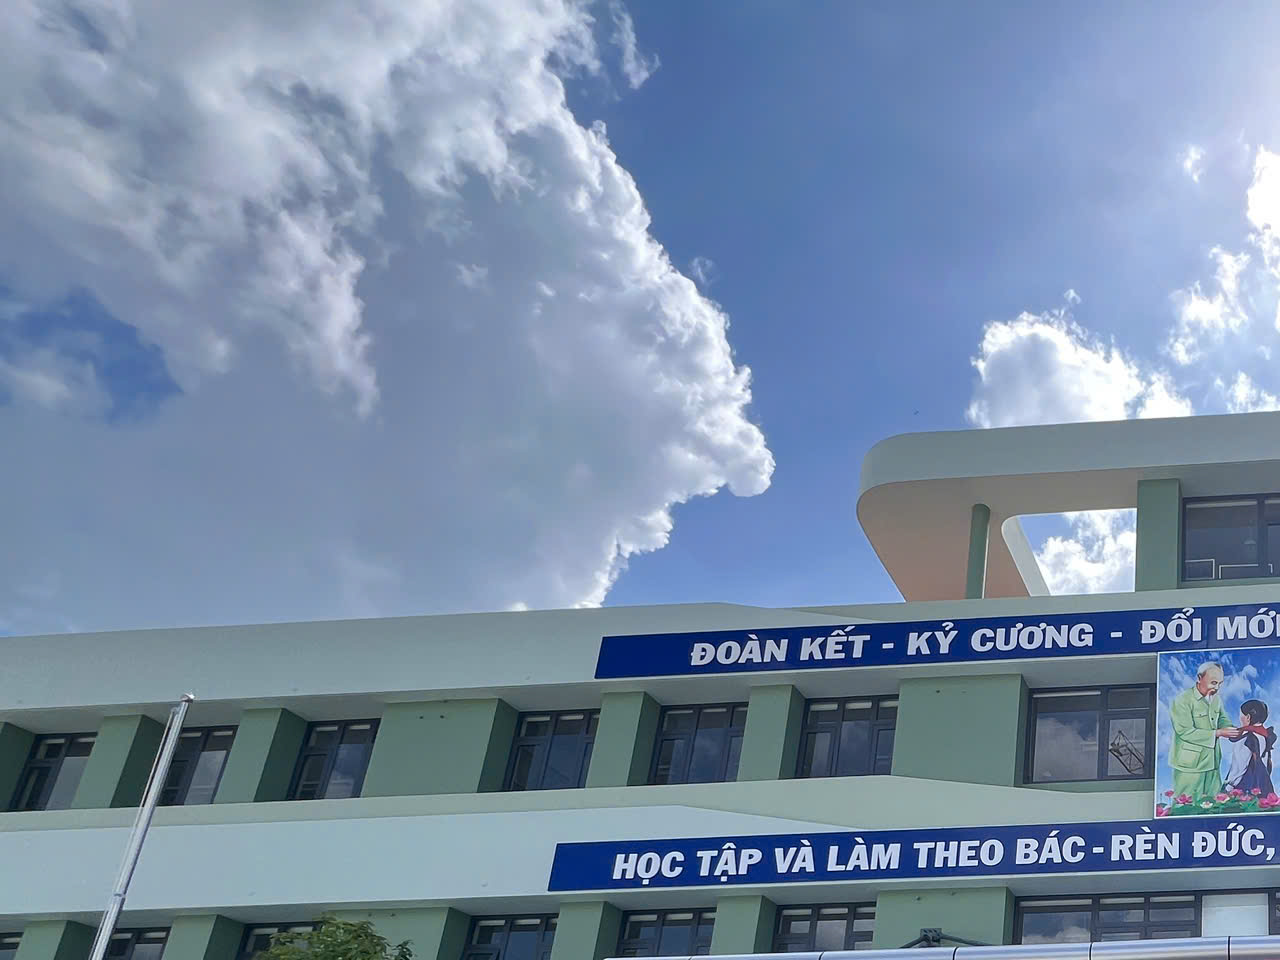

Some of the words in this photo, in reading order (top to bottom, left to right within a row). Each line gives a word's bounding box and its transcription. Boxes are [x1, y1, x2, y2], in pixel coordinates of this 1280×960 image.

[690, 634, 789, 666] ĐOÀN
[799, 625, 871, 661] KẾT
[907, 622, 960, 656] KỶ
[970, 621, 1094, 652] CƯƠNG
[1139, 606, 1202, 644] ĐỔI
[612, 851, 685, 885] HỌC
[696, 842, 763, 882] TẬP
[774, 839, 815, 874] VÀ
[826, 837, 901, 872] LÀM
[913, 839, 1004, 868] THEO
[1191, 822, 1276, 861] ĐỨC,
